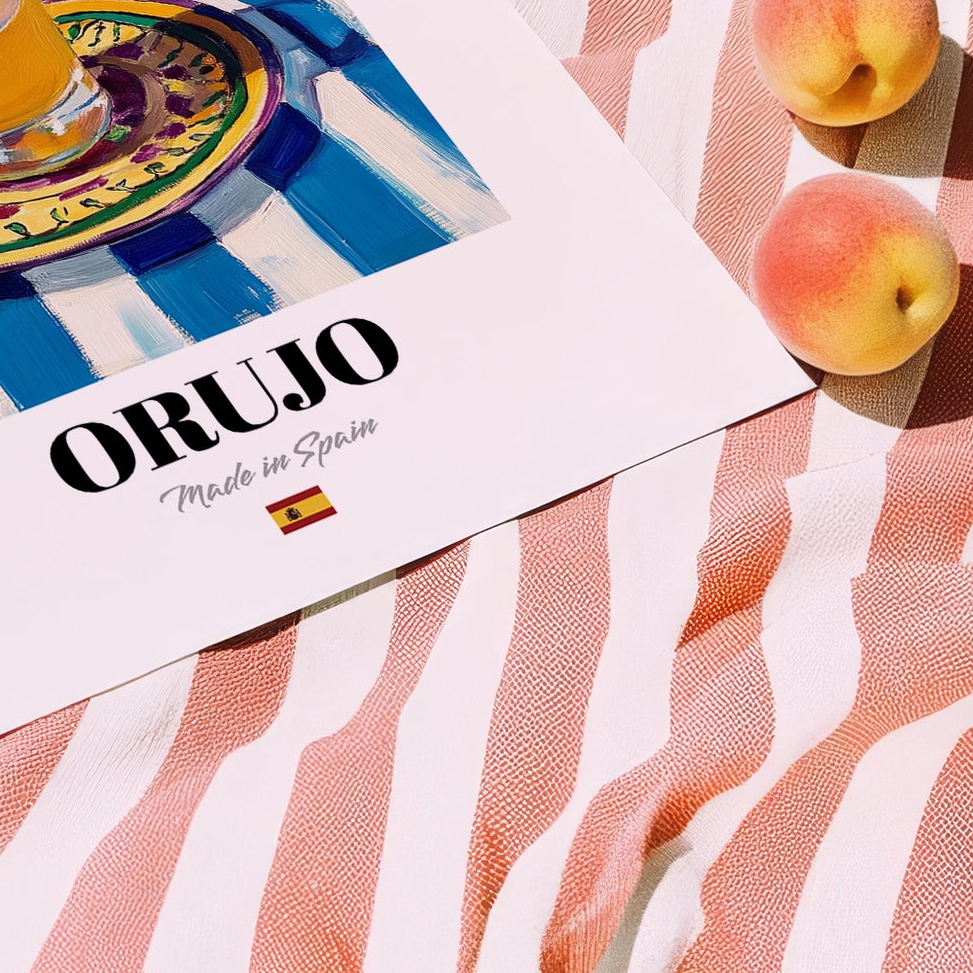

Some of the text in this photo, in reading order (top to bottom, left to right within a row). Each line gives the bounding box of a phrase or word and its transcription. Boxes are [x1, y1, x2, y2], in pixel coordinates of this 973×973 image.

[49, 317, 400, 494] ORUJO
[158, 417, 380, 514] Made in Spain
